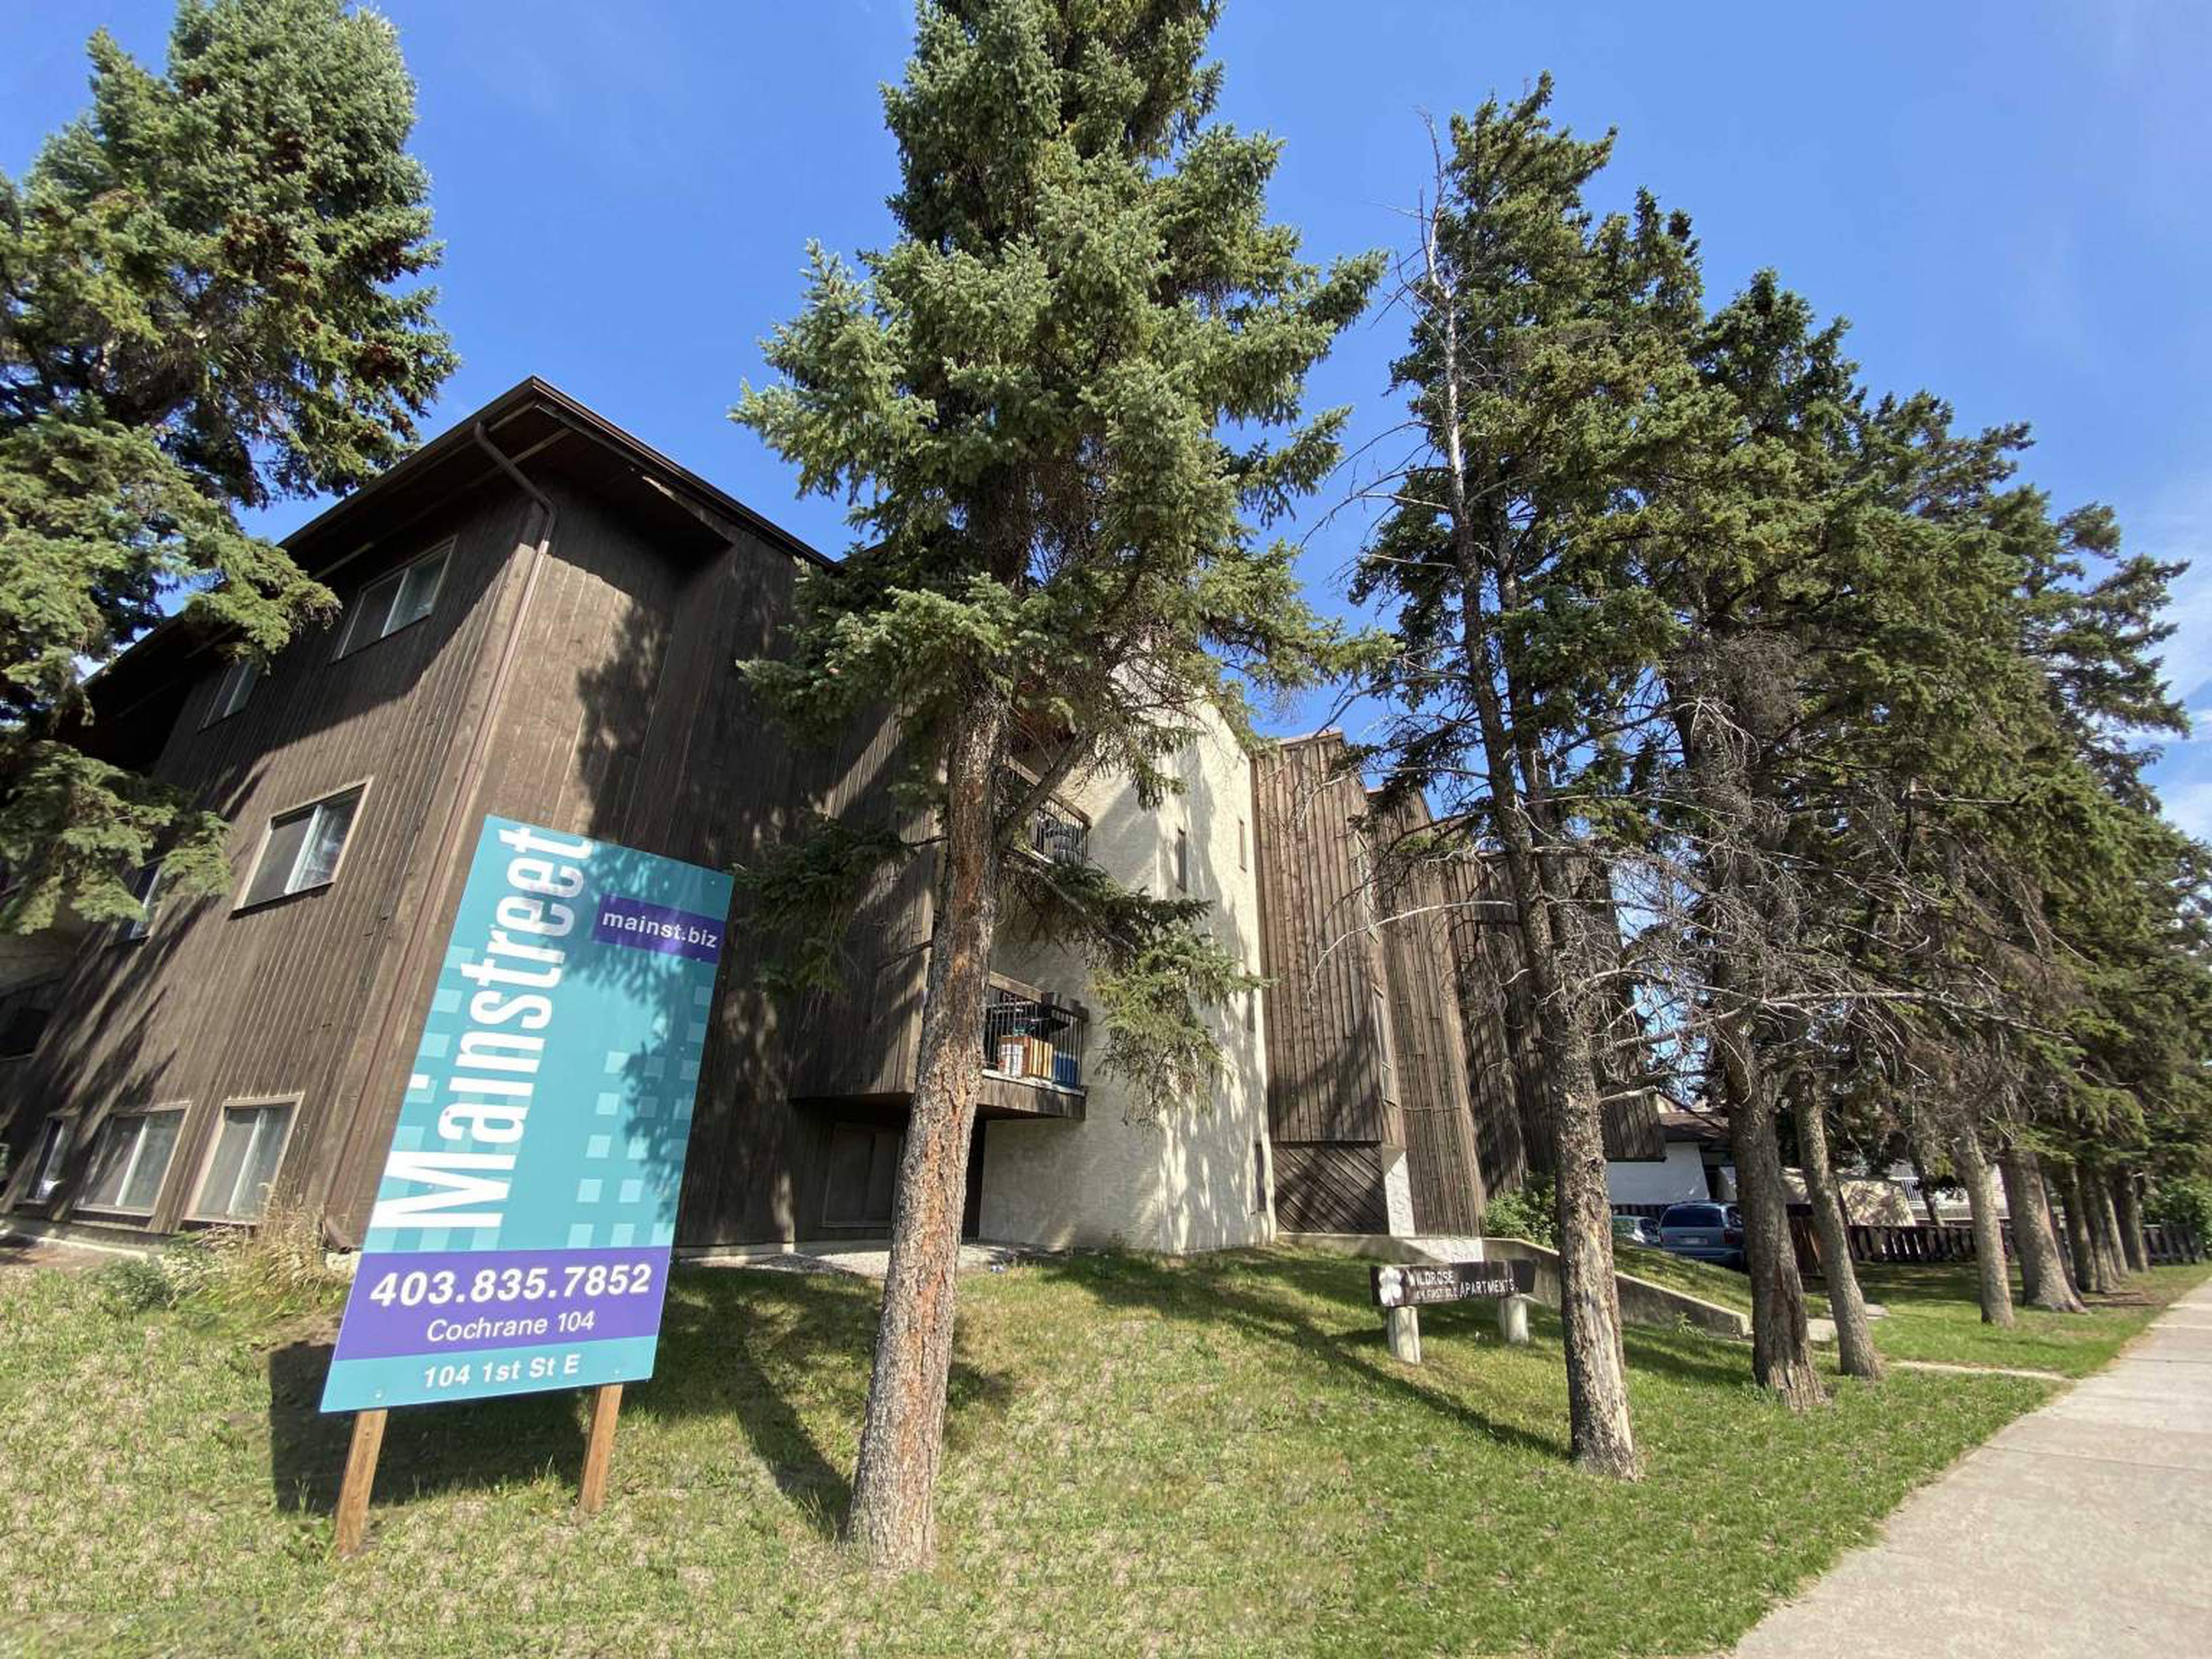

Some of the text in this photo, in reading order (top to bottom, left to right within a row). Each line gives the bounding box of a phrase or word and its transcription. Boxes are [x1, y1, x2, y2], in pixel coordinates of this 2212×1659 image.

[603, 912, 718, 948] mainst.biz
[368, 826, 594, 1228] Mainstreet
[369, 1264, 652, 1307] 403.835.7852
[1406, 1270, 1455, 1286] WILDROSE
[427, 1310, 595, 1342] Cochrane 104
[424, 1354, 581, 1388] 104 1st St E
